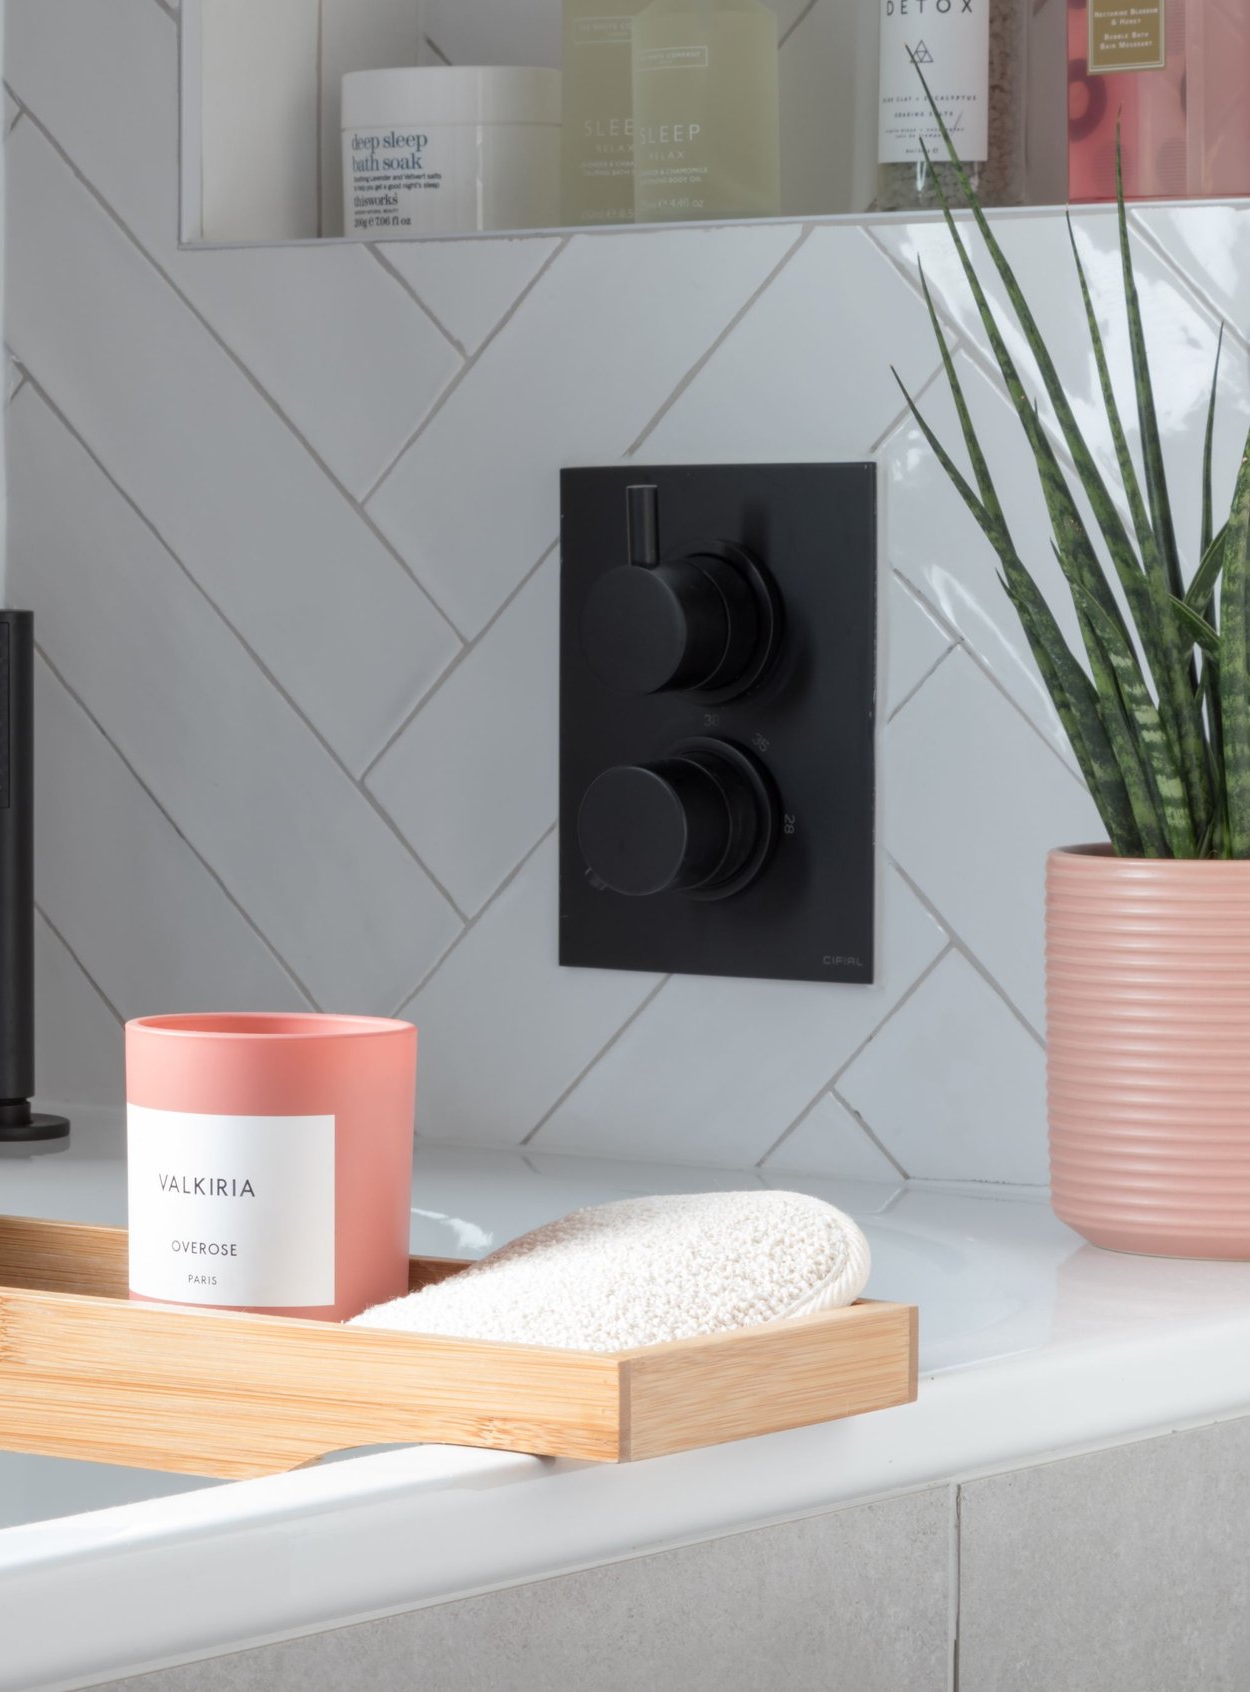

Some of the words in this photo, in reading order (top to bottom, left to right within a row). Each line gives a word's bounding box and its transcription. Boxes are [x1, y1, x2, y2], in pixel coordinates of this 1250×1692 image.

[886, 0, 973, 16] DETOX
[924, 94, 977, 102] ECALYPTUS
[583, 118, 634, 137] SLEE
[638, 123, 701, 145] SLEEP
[351, 133, 380, 154] deep
[382, 130, 429, 153] sleep
[352, 154, 380, 173] bath
[382, 152, 424, 171] soak
[387, 183, 401, 191] good
[400, 216, 412, 226] oz
[784, 813, 796, 835] 28
[823, 955, 863, 967] CIFIAL
[158, 1173, 256, 1198] VALKIRIA
[171, 1239, 238, 1257] OVEROSE
[188, 1274, 218, 1286] PARIS
